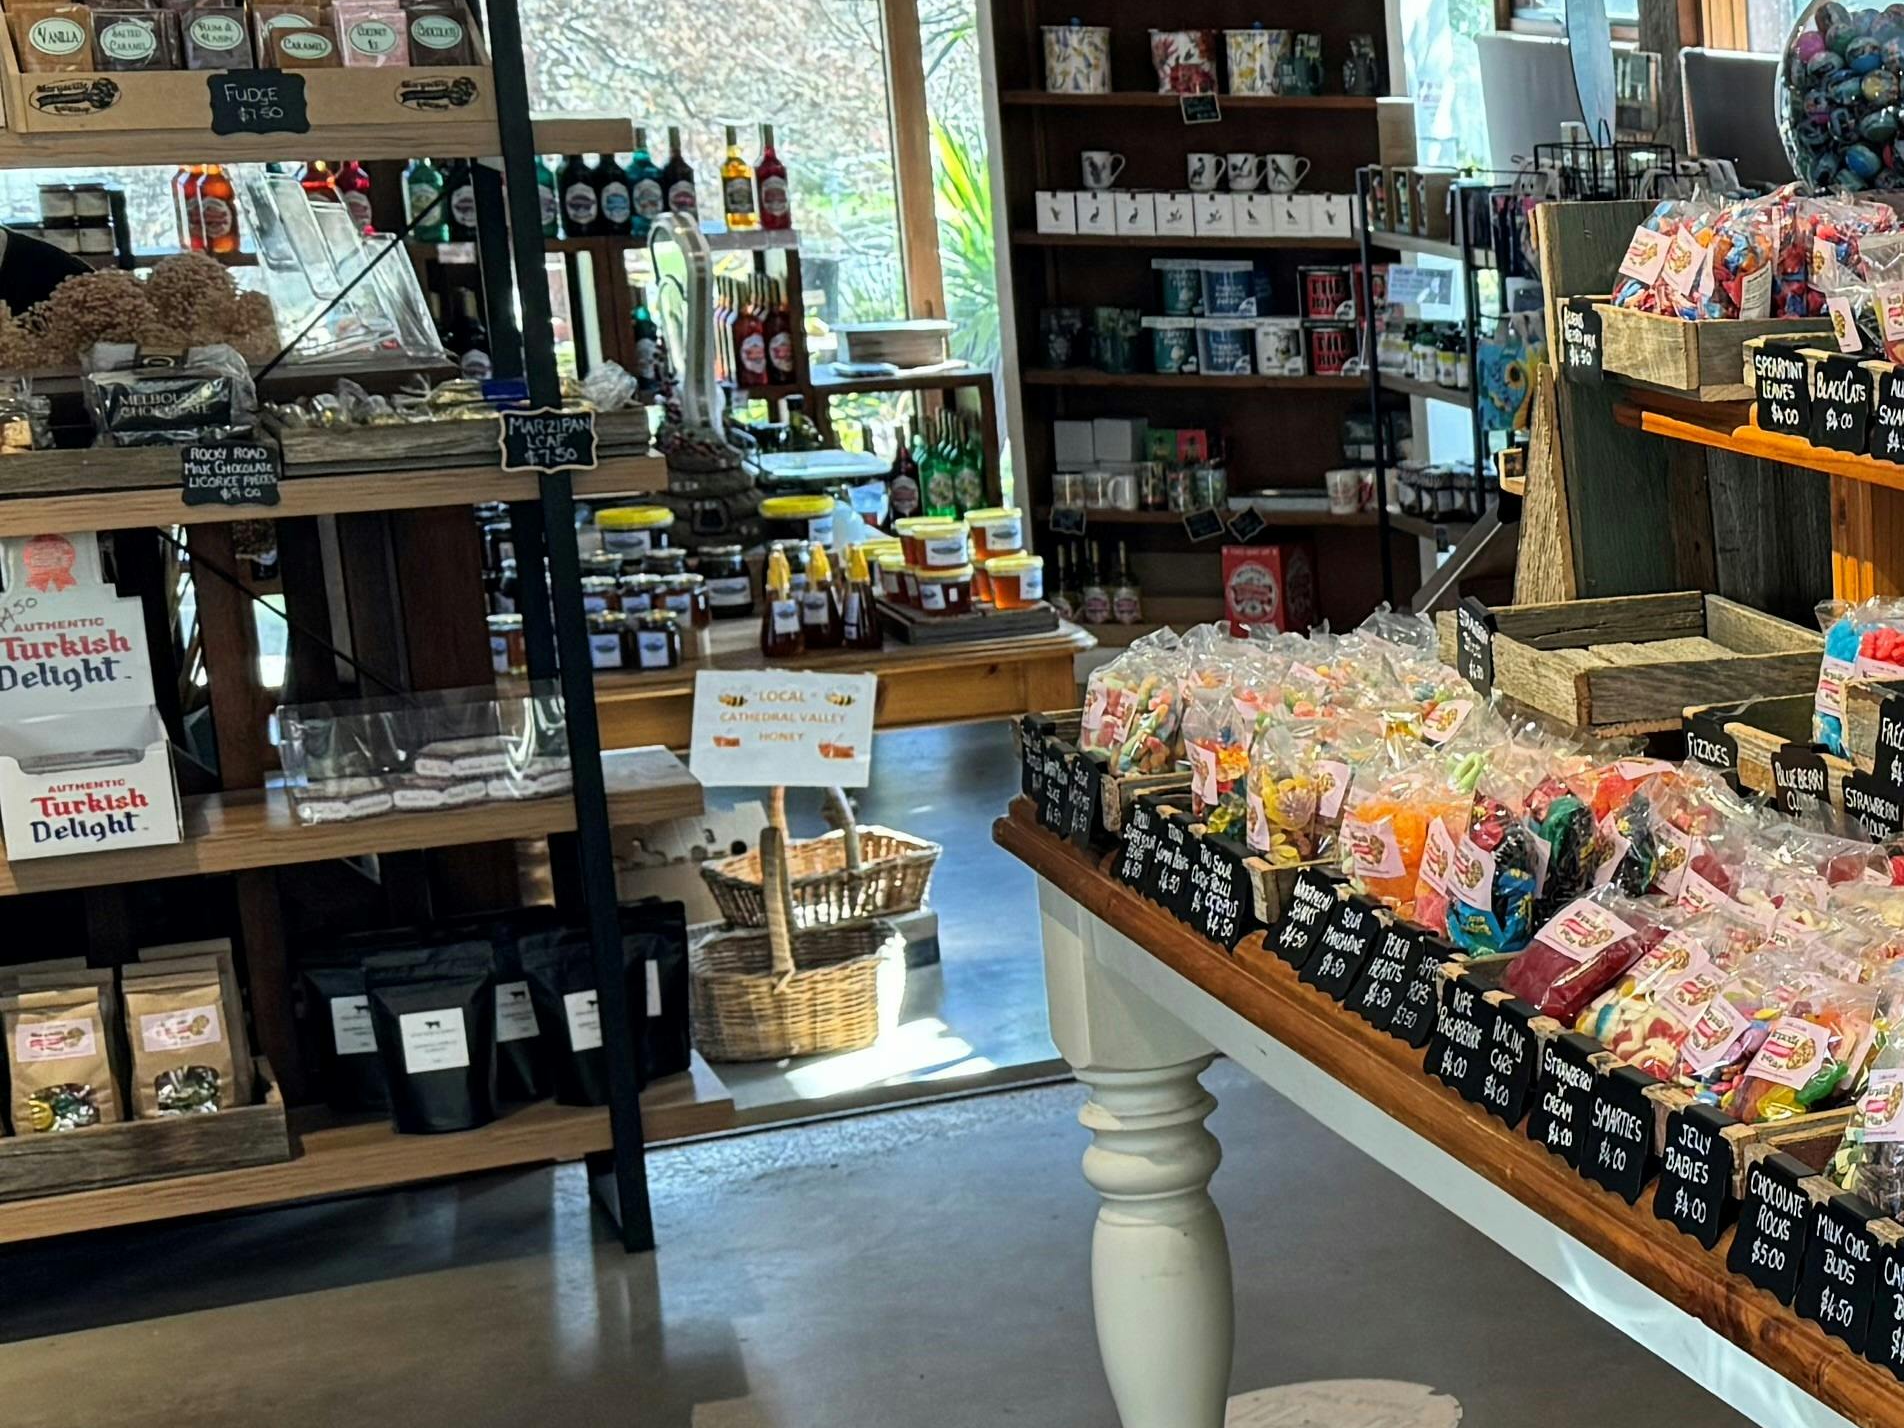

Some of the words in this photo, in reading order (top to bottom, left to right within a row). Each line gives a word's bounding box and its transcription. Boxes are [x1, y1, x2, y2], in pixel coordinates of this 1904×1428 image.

[38, 28, 80, 44] VANILLA
[284, 39, 328, 52] CARAMEL
[223, 83, 278, 107] FUDGE
[1755, 354, 1803, 380] SPEARMINT
[1762, 380, 1796, 400] LEAVES
[509, 417, 590, 435] MARZIPAN
[234, 447, 267, 460] ROAD
[189, 476, 239, 488] LICORICE
[14, 618, 104, 633] AUTHENTIC
[0, 629, 132, 662] Turkish
[0, 657, 121, 692] Delight
[758, 690, 806, 703] LOCAL
[719, 712, 797, 724] CATHEDRAL
[799, 713, 845, 724] VALLEY
[758, 731, 804, 743] HONEY
[47, 778, 126, 793] AUTHENTIC
[31, 789, 149, 819] Turkish
[31, 812, 137, 844] Delight
[1543, 1047, 1594, 1092] STRAWBERRY
[1543, 1093, 1573, 1122] CREAM
[1593, 1095, 1643, 1142] SMARTIES
[1679, 1123, 1713, 1155] JELLY
[1665, 1144, 1710, 1185] BABIES
[1750, 1170, 1805, 1220] CHOCOLATE
[1756, 1202, 1791, 1242] ROCKS
[1824, 1249, 1856, 1285] BUDS
